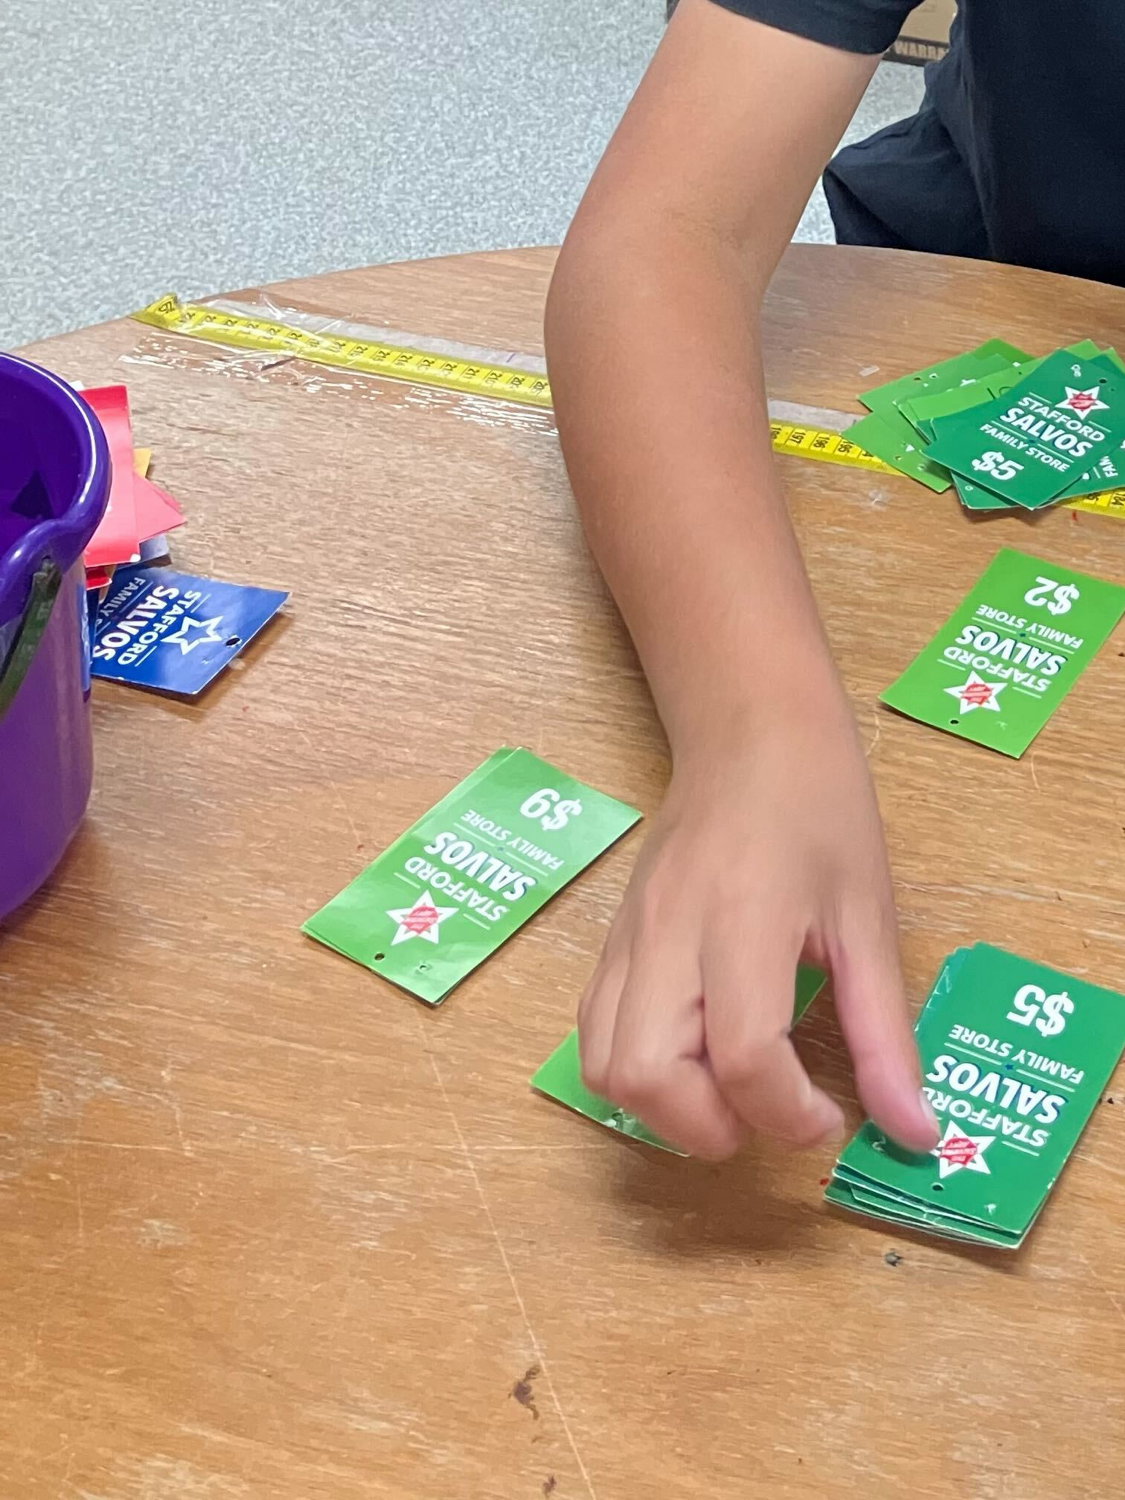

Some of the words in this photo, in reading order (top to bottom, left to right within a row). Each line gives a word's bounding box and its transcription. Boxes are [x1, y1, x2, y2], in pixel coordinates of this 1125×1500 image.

[790, 431, 806, 444] 197
[813, 436, 830, 449] 196
[1000, 407, 1093, 457] SALVOS
[1017, 396, 1106, 442] STAFFORD
[971, 451, 1025, 481] $5
[979, 423, 1029, 450] FAMILY
[1025, 447, 1070, 473] STORE
[1099, 455, 1119, 478] FAM
[100, 576, 147, 617] FAMILY
[975, 604, 1028, 629] STORE
[1024, 575, 1080, 616] $2
[93, 585, 180, 662] SALVOS
[117, 589, 202, 666] STAFFORD
[1025, 623, 1084, 649] FAMILY
[943, 646, 1052, 692] STAFFORD
[954, 624, 1068, 676] SALVOS
[460, 809, 513, 843] STORE
[519, 787, 584, 831] $9
[423, 831, 538, 901] SALVOS
[506, 836, 565, 870] FAMILY
[404, 856, 511, 922] STAFFORD
[1005, 983, 1075, 1038] $5
[948, 1024, 1014, 1058] STORE
[925, 1054, 1068, 1124] SALVOS
[1011, 1049, 1085, 1085] FAMILY
